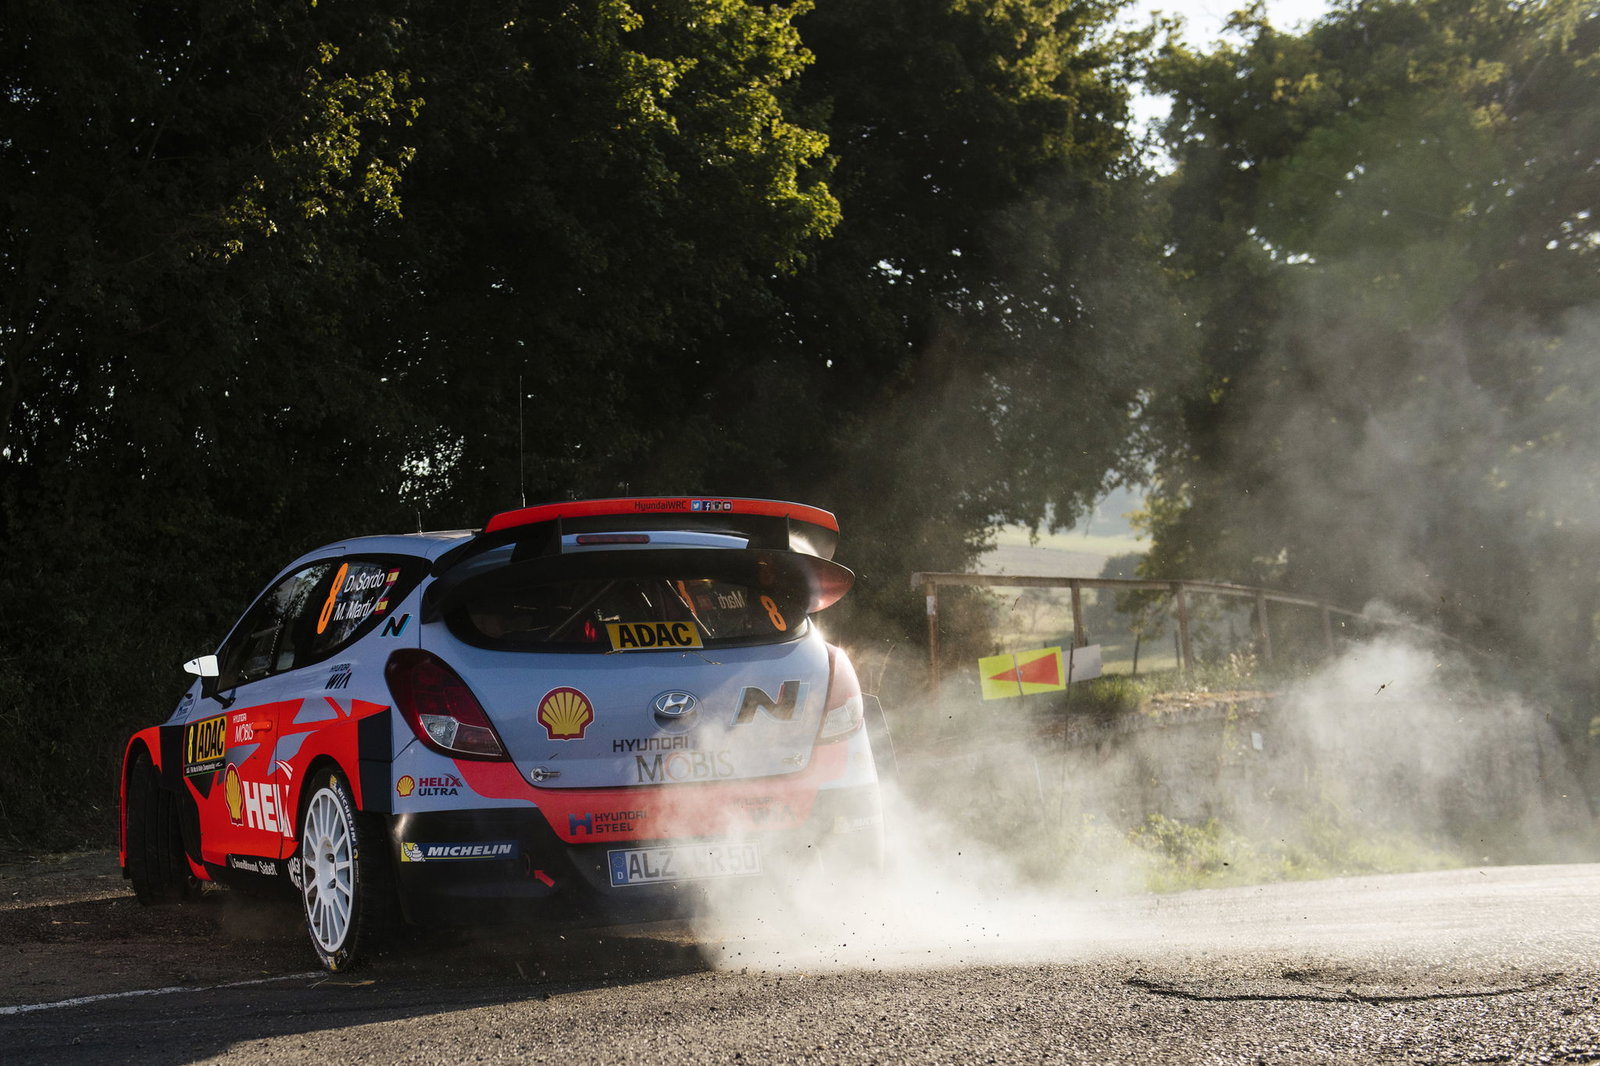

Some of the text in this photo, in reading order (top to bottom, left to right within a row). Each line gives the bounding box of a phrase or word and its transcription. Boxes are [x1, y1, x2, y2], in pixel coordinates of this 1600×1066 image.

[634, 500, 687, 511] HyundaiWRC
[355, 569, 385, 588] Sordo
[317, 563, 348, 634] 8
[759, 595, 787, 632] 8
[618, 623, 692, 648] ADAC
[187, 718, 225, 764] 8 ADAC
[612, 736, 688, 752] HYUNDAI
[635, 749, 735, 783] MOBIS
[418, 776, 464, 788] HELIX
[418, 787, 458, 797] ULTRA
[594, 811, 647, 822] HYUNDAI
[595, 823, 635, 833] STEEL
[427, 844, 512, 857] MICHELIN
[628, 850, 676, 880] ALZ
